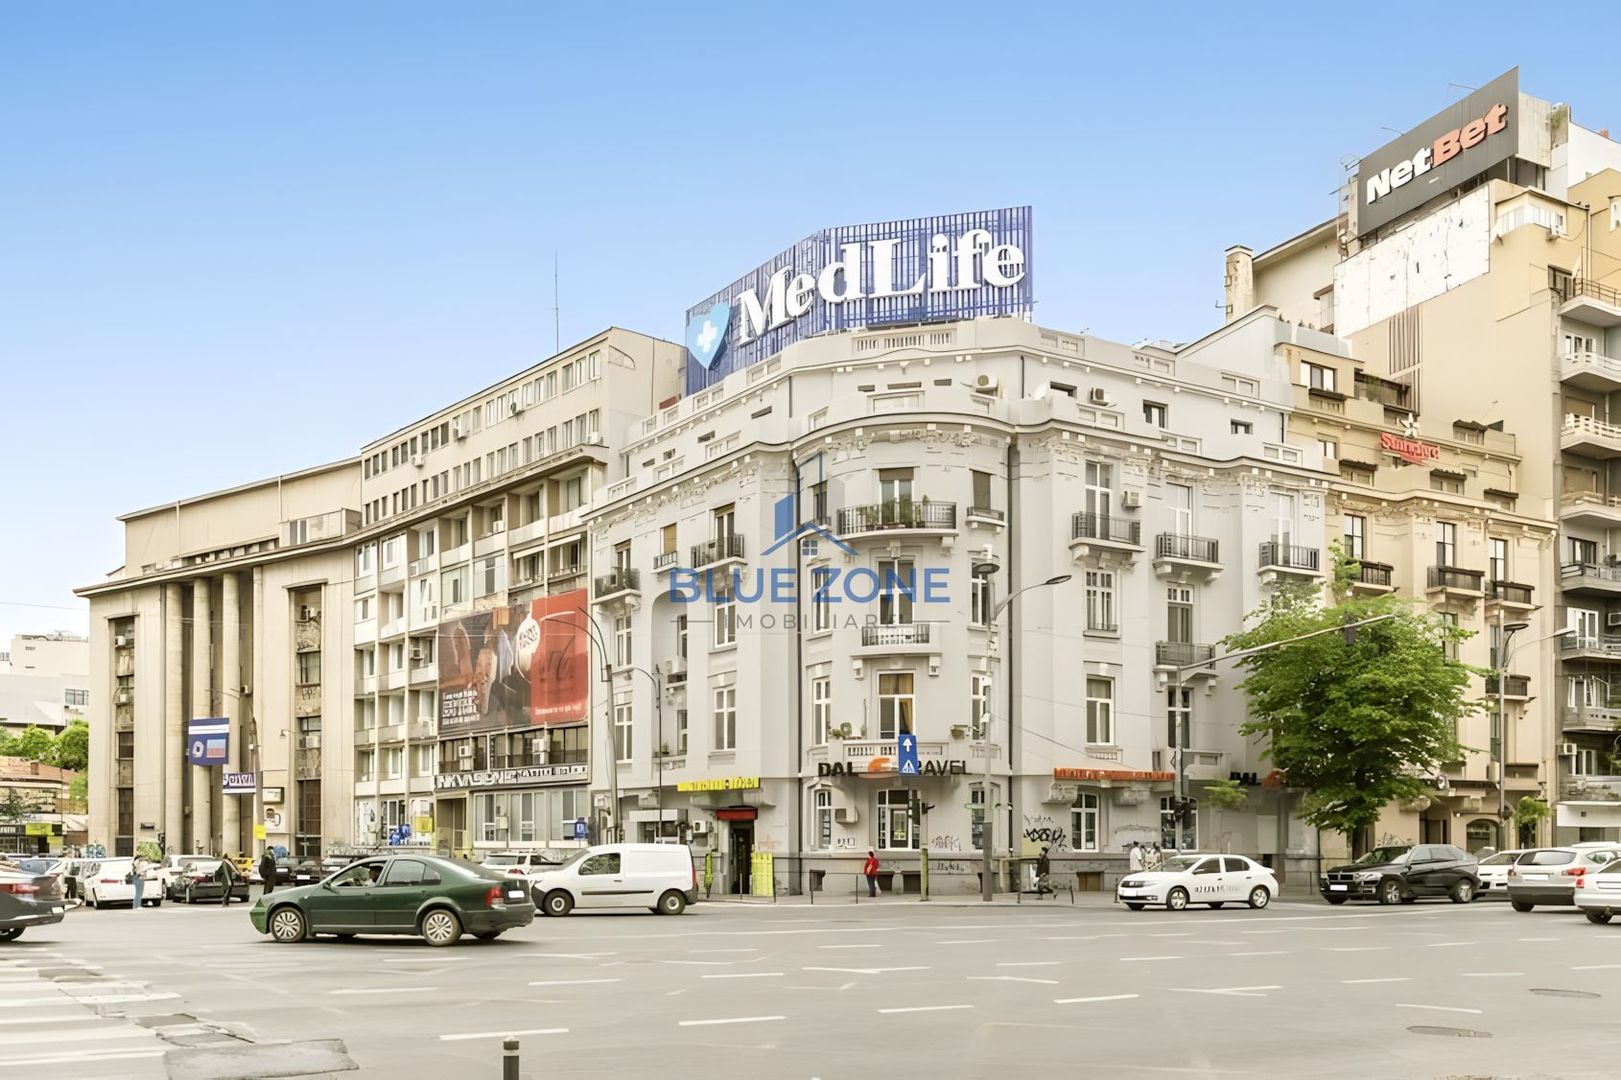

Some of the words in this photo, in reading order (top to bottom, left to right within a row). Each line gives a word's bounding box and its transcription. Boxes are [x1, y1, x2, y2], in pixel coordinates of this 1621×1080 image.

[1366, 103, 1509, 206] NetBet
[733, 228, 1026, 348] MedLife
[818, 761, 858, 777] DAL
[917, 759, 972, 776] AVEL
